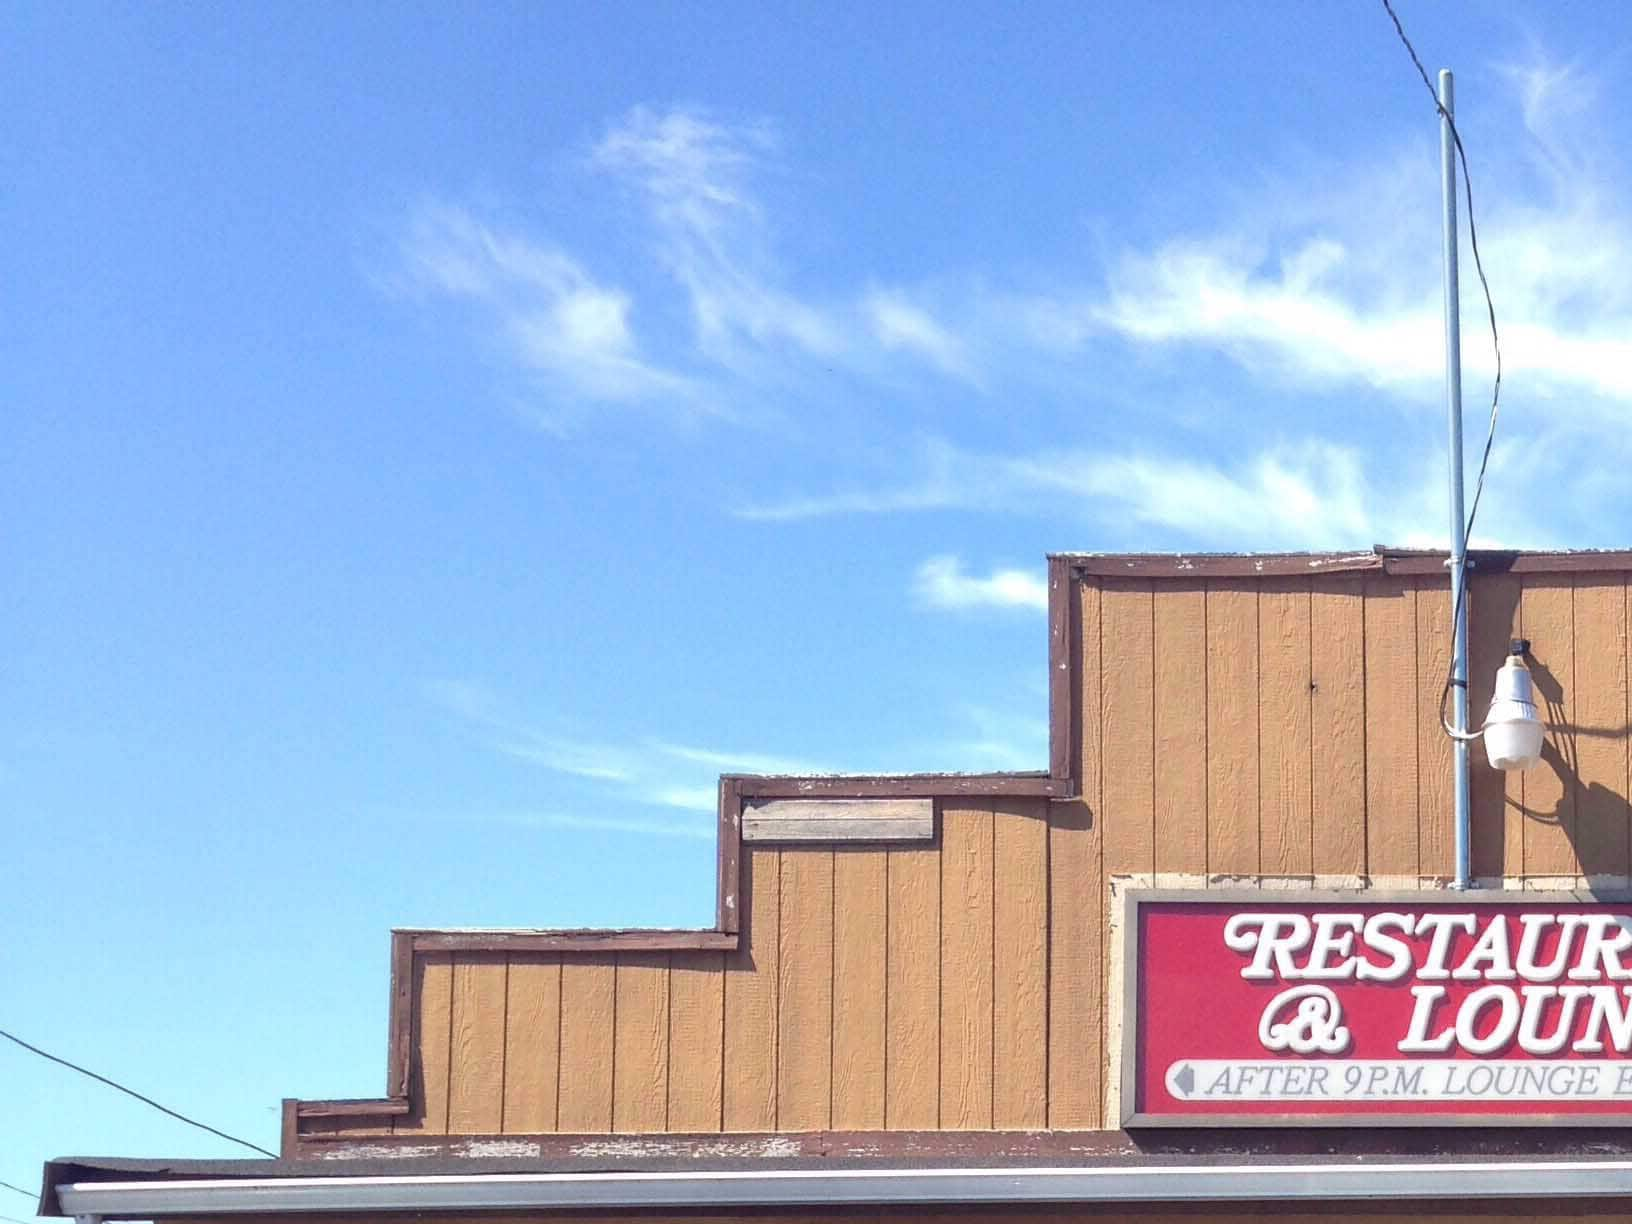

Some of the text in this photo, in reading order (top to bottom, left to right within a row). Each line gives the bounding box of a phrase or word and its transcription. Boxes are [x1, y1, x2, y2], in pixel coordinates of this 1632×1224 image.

[1258, 984, 1350, 1052] &
[1204, 1066, 1327, 1096] AFTER
[1440, 1065, 1600, 1096] LOUNGE
